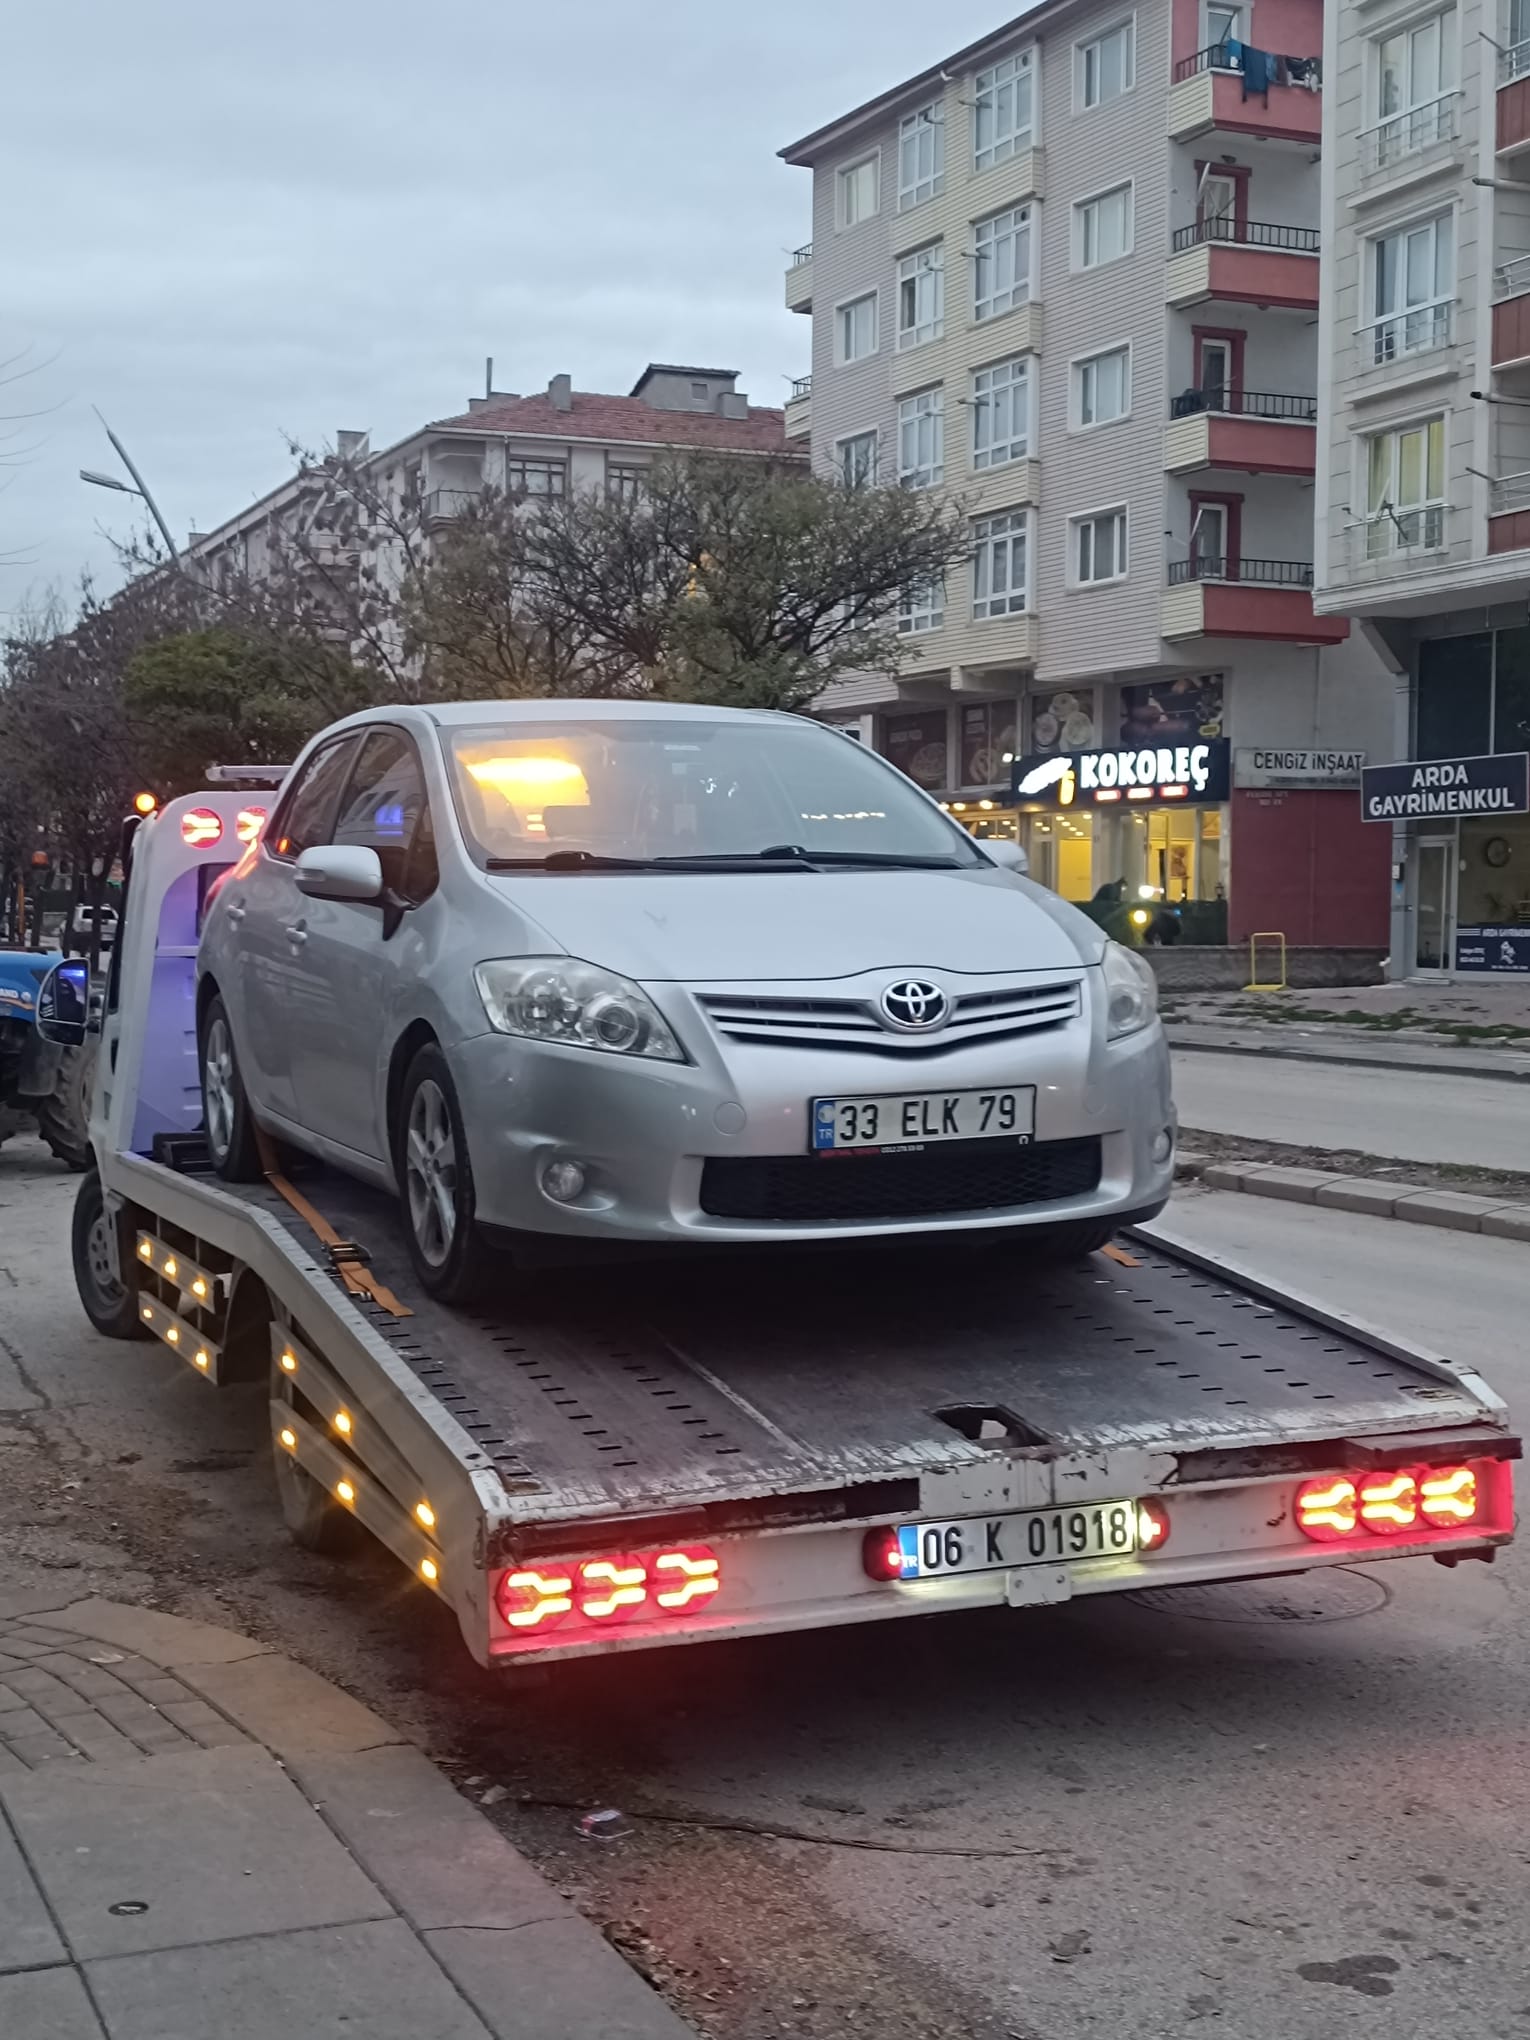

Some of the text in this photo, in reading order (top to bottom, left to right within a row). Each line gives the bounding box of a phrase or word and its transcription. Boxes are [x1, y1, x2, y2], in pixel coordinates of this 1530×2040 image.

[1080, 745, 1209, 791] KOKOREÇ
[1254, 752, 1307, 770] CENGİZ
[1411, 764, 1469, 788] ARDA
[1369, 787, 1515, 816] GAYRİMENKUL
[839, 1094, 1016, 1141] 33 ELK 79
[818, 1128, 833, 1139] TR
[923, 1508, 1127, 1569] 06 K 01918
[901, 1555, 918, 1568] TR
